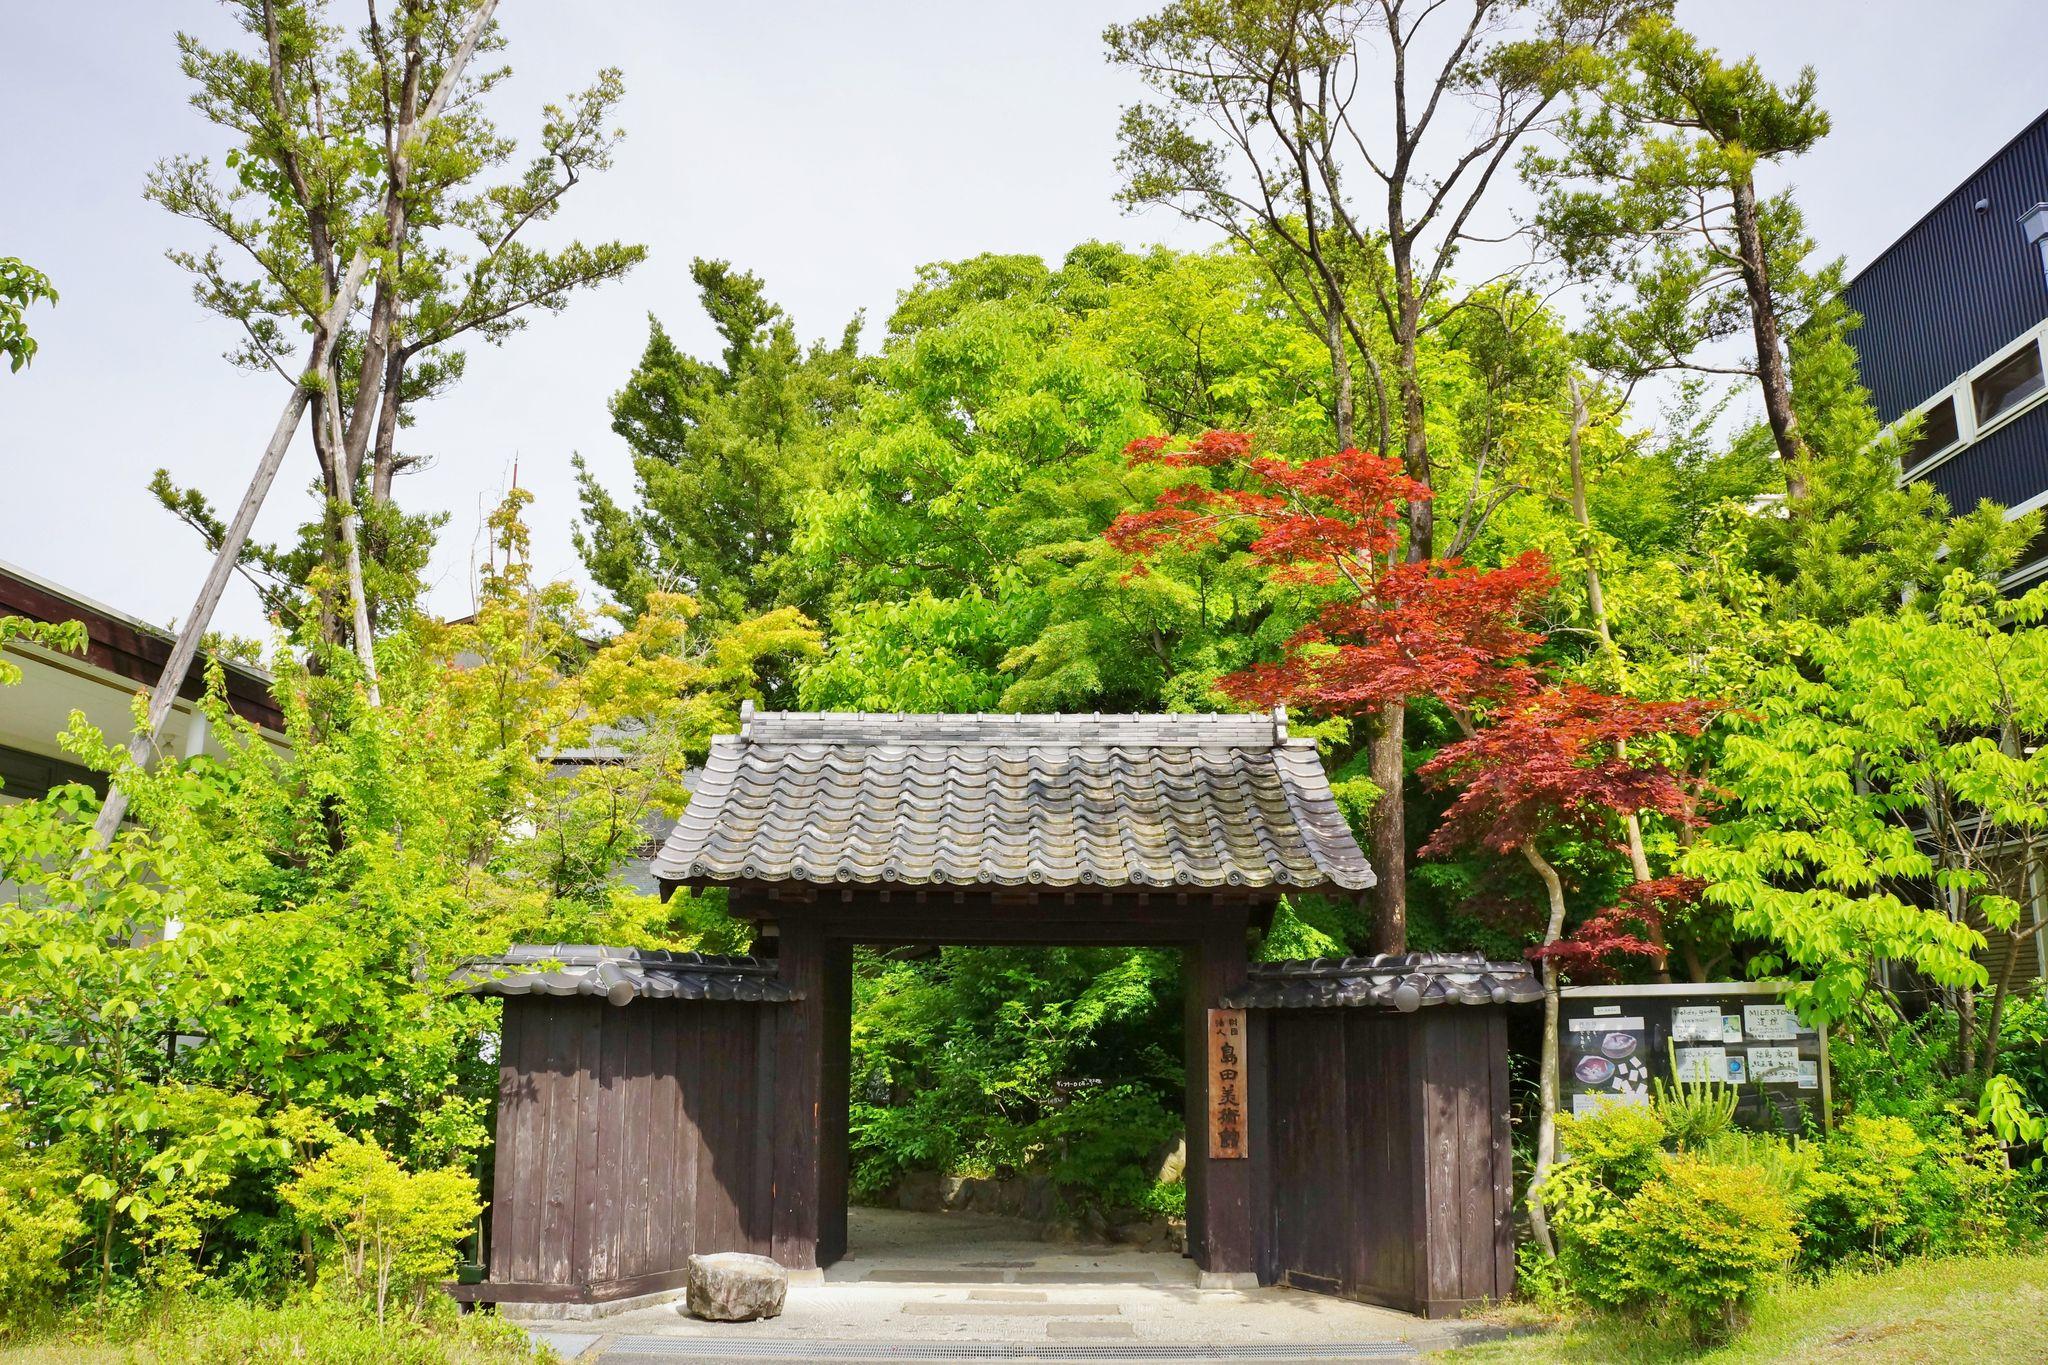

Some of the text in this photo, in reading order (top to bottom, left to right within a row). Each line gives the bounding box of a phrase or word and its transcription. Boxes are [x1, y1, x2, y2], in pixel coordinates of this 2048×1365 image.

[1217, 1042, 1240, 1149] 島田美術館
